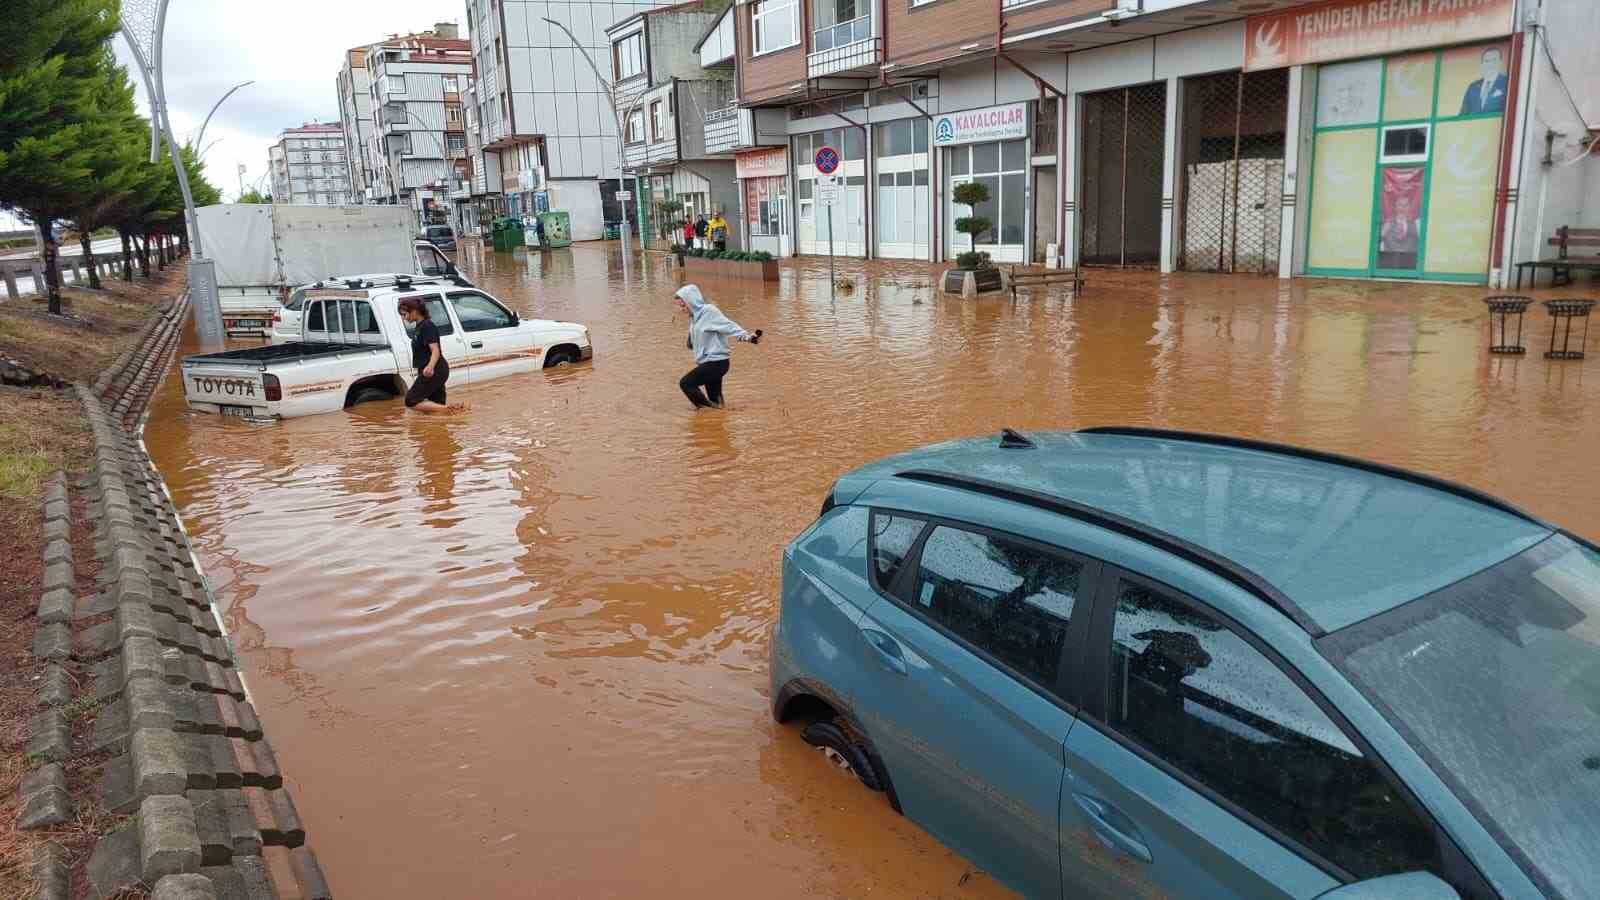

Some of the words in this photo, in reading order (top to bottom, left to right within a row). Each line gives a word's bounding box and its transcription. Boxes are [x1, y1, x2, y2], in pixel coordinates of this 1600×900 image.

[1296, 10, 1361, 34] YENİDEN
[1368, 1, 1421, 25] REFAH
[193, 378, 256, 397] TOYOTA
